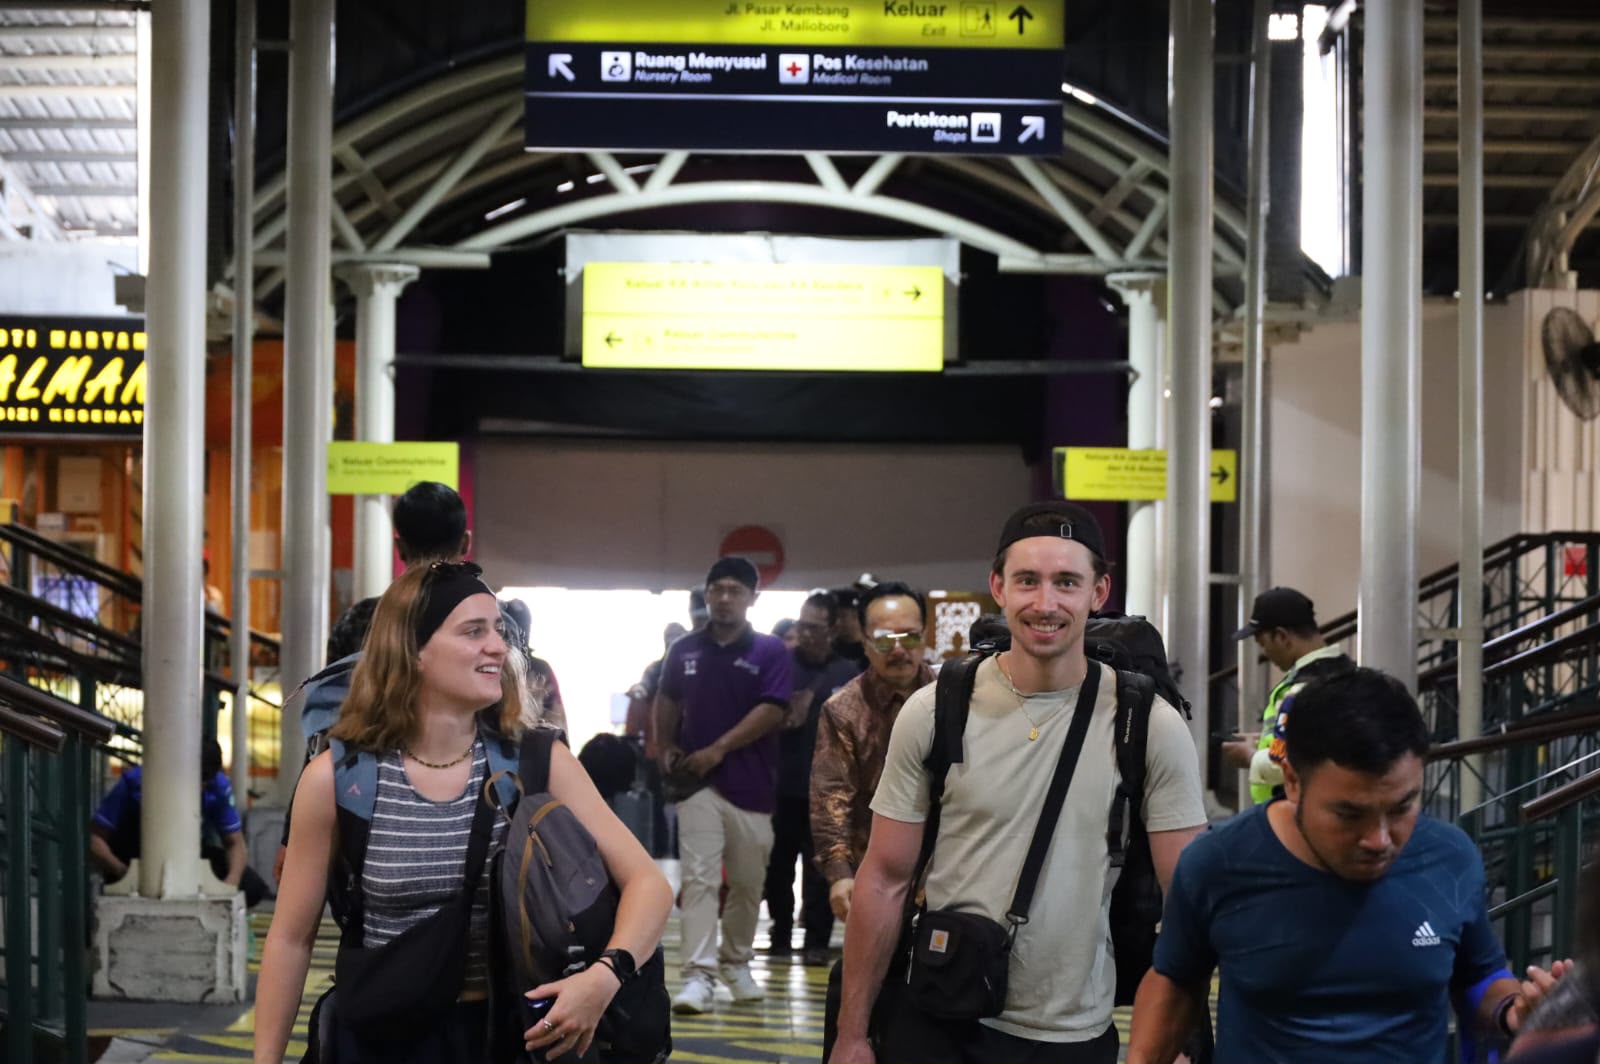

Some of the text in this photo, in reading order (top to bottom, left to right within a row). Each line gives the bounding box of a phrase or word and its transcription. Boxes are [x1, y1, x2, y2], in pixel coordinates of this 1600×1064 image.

[746, 4, 783, 16] Pasar
[786, 5, 849, 19] Kembang
[884, 0, 947, 17] Keluar
[780, 20, 849, 33] Malioboro
[921, 24, 947, 37] Exit
[635, 51, 767, 71] Ruang Menyusui
[813, 54, 928, 71] Pos Kesehatan
[635, 69, 712, 84] Nursery Room
[813, 72, 892, 85] Medical Room
[887, 111, 969, 128] Pertokoan
[933, 129, 967, 143] Shops
